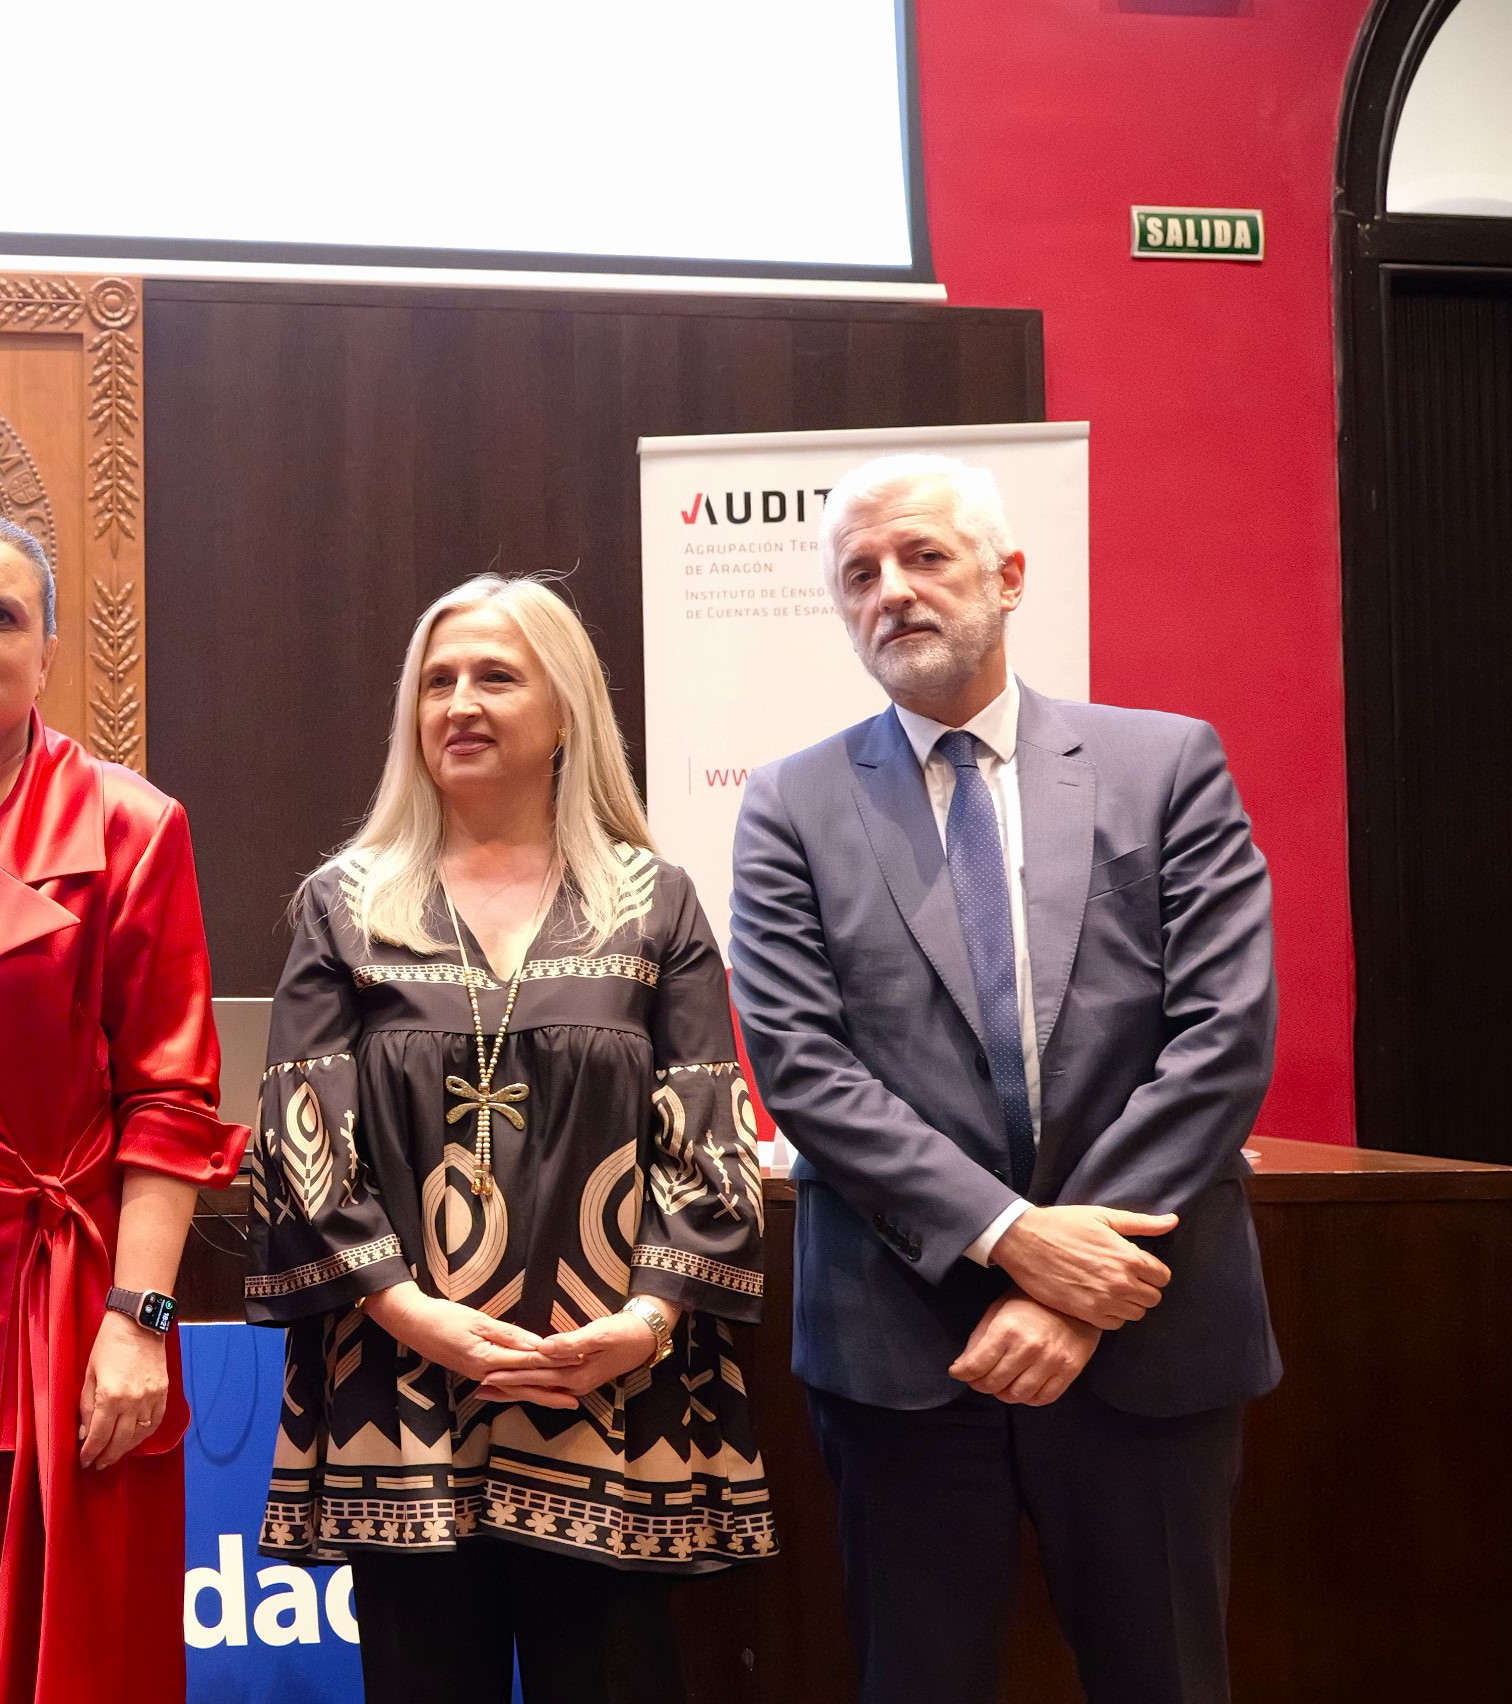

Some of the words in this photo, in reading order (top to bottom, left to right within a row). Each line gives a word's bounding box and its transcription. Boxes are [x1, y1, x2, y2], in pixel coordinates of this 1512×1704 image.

[1146, 216, 1252, 249] SALIDA
[685, 541, 784, 555] AGRUPACIÓN
[685, 565, 703, 576] DE
[710, 561, 773, 575] ARAGÓN
[685, 589, 756, 601] INSTITUTO
[761, 588, 776, 598] DE
[686, 609, 702, 620] DE
[707, 607, 769, 618] CUENTAS
[773, 606, 788, 617] DE
